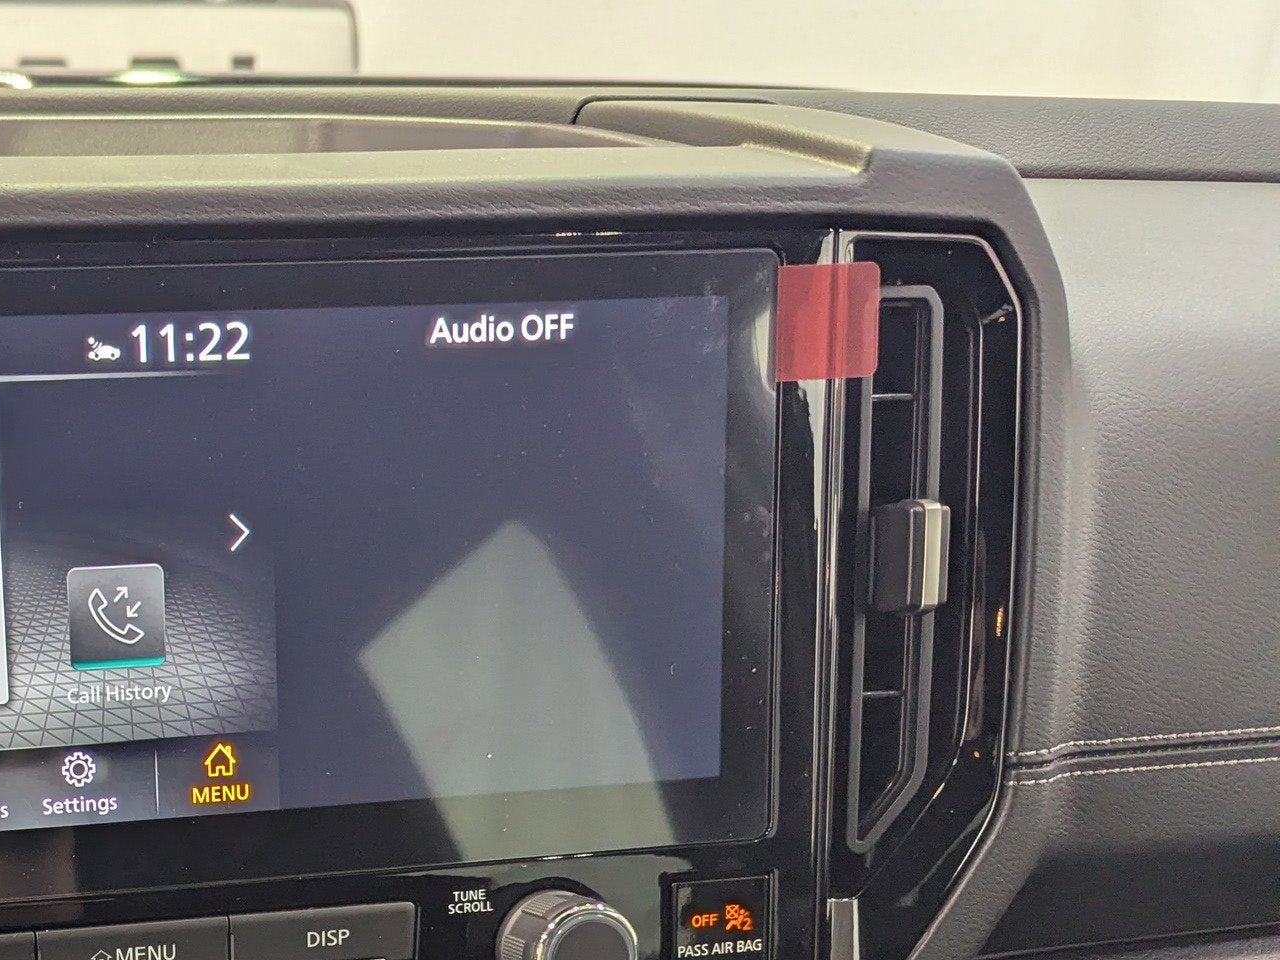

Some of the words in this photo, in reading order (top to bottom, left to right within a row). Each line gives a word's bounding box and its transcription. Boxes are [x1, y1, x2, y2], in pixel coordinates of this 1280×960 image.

[430, 314, 514, 345] Audio
[521, 312, 576, 341] OFF
[131, 322, 251, 364] 11:22
[67, 685, 101, 705] Call
[106, 682, 172, 705] History
[192, 782, 250, 805] MENU
[41, 791, 118, 819] Settings
[453, 889, 487, 902] TUNE
[448, 901, 494, 914] SCROLL
[691, 913, 719, 928] OFF
[306, 928, 352, 949] DISP
[677, 943, 710, 959] PASS
[712, 941, 734, 956] AIR
[736, 939, 763, 954] BAG
